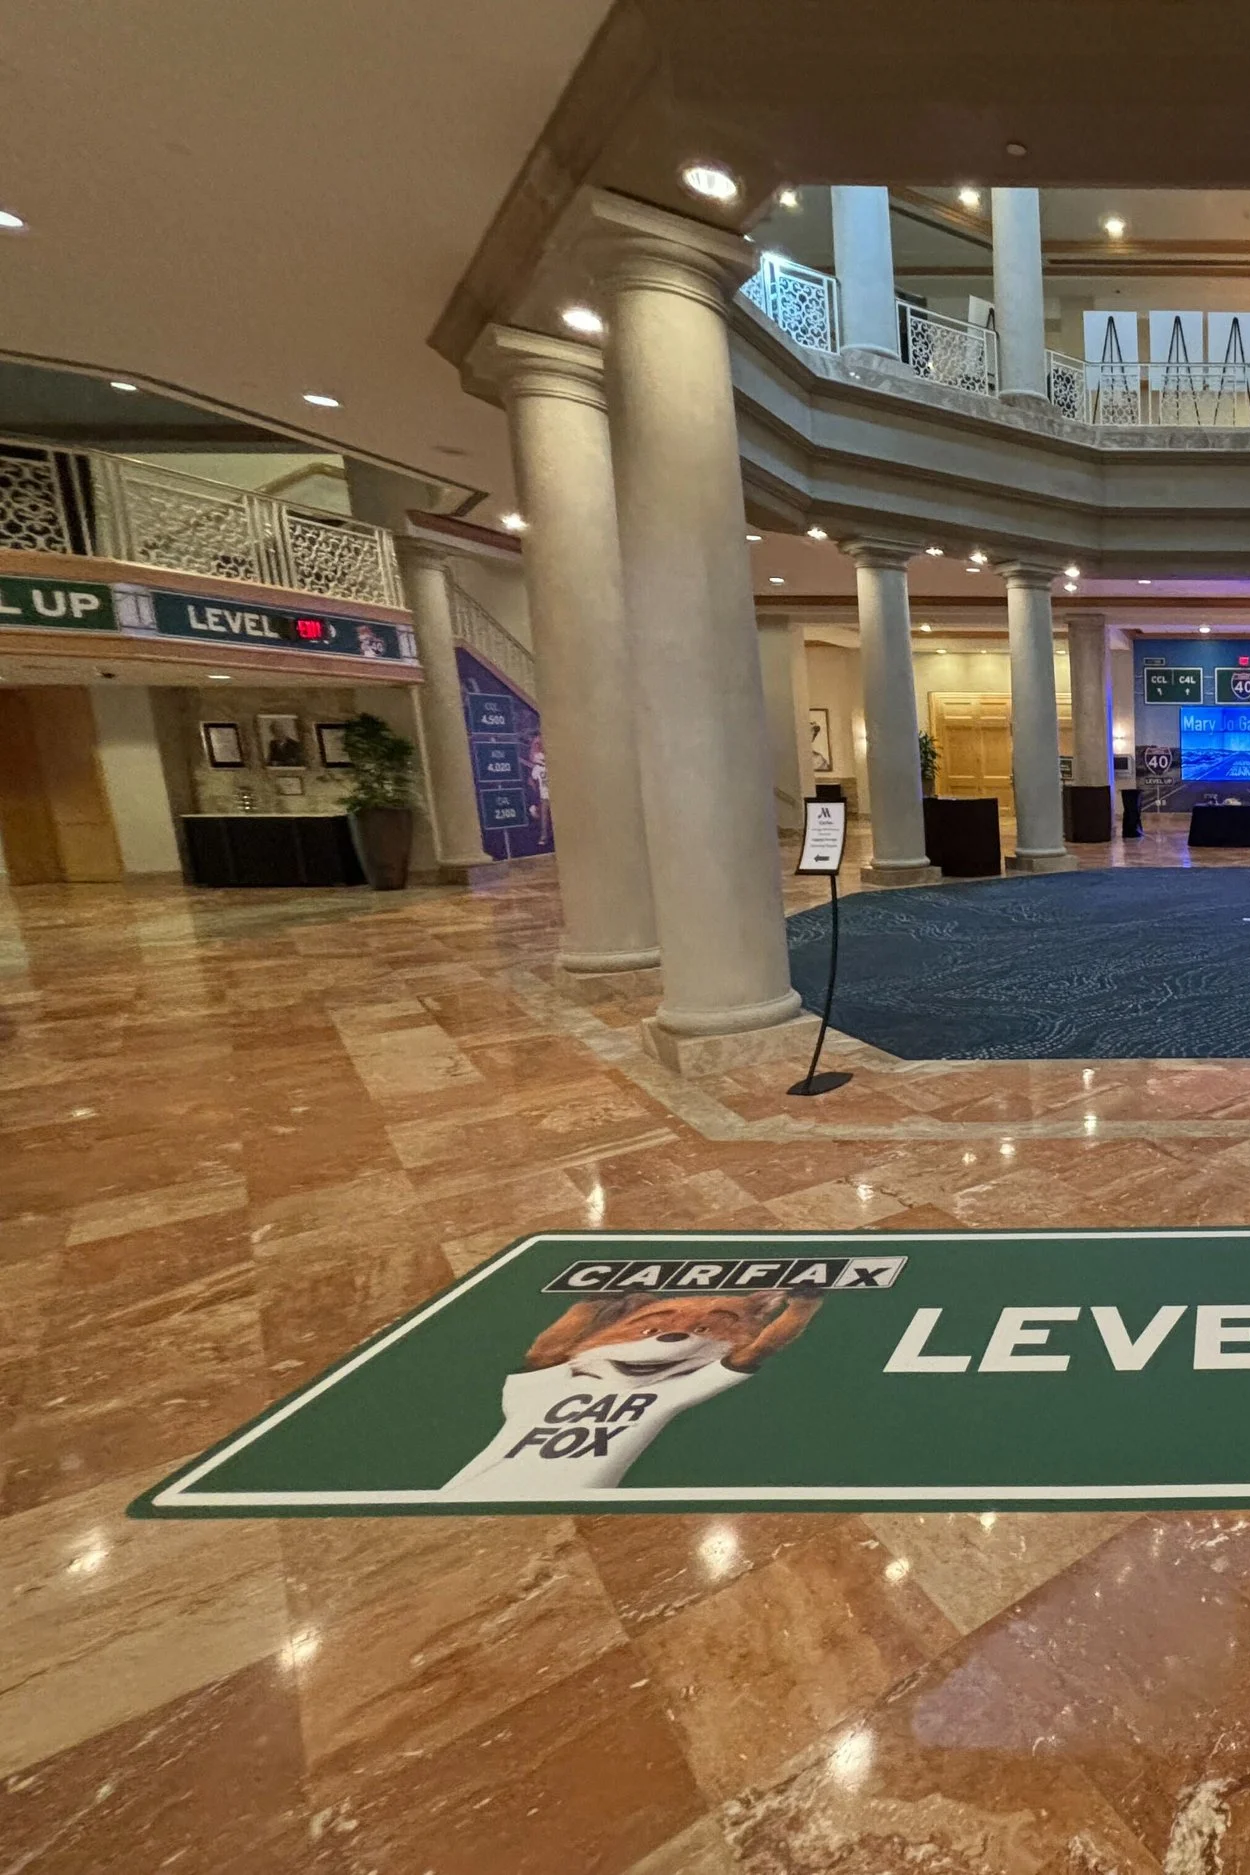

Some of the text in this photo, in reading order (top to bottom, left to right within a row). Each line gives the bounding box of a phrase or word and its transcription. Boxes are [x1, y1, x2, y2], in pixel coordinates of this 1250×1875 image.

[32, 589, 100, 618] UP
[187, 604, 281, 639] LEVEL
[1151, 676, 1167, 684] CCL
[1179, 676, 1197, 684] C4L
[1183, 715, 1216, 735] Mary
[1221, 716, 1235, 732] Jo
[1148, 755, 1169, 769] 40
[562, 1261, 898, 1290] CARFAX
[544, 1394, 658, 1424] CAR
[504, 1427, 628, 1459] FOX
